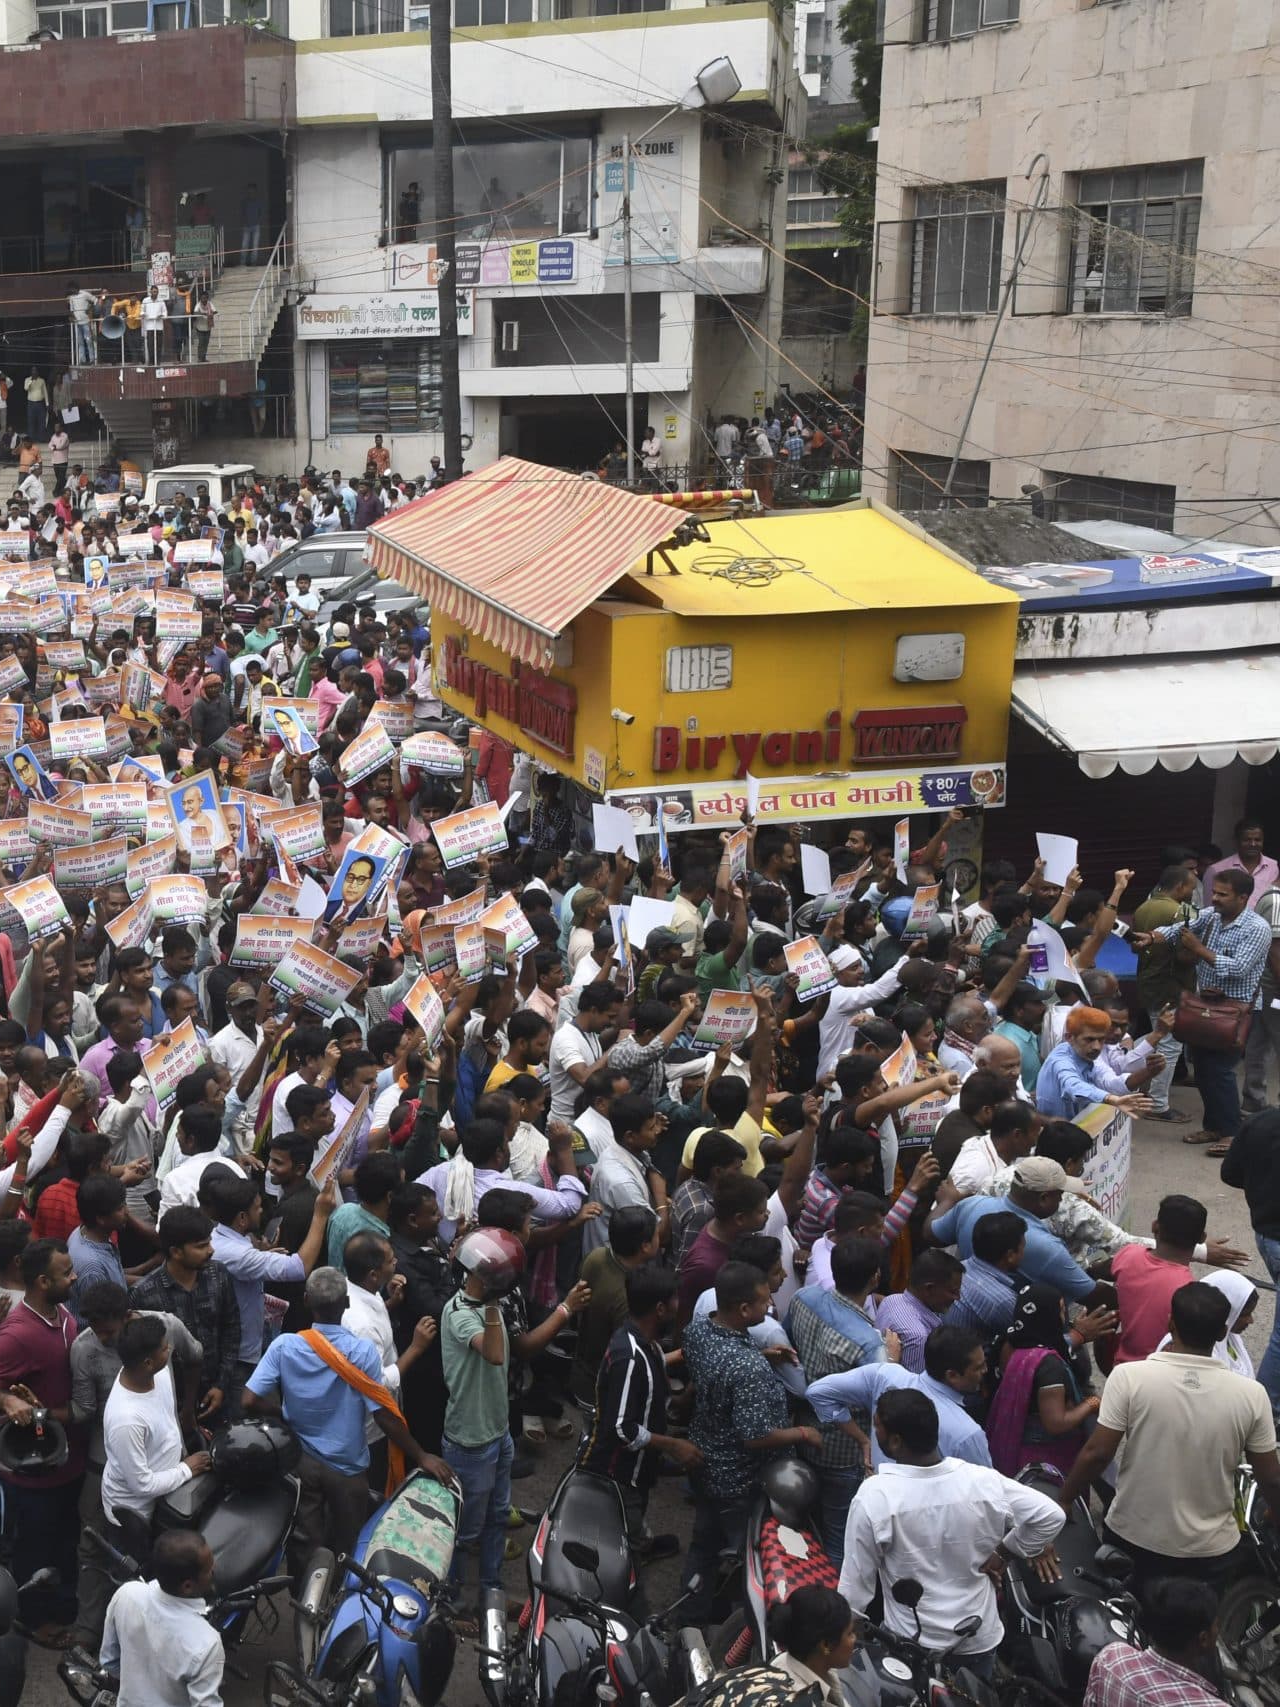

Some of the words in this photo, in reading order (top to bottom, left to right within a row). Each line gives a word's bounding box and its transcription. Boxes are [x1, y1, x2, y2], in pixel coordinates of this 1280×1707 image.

[645, 142, 674, 155] ZONE
[653, 710, 841, 779] Biryani
[859, 723, 961, 756] WINDOW
[790, 790, 837, 809] पाव
[847, 780, 914, 806] भाजी
[936, 791, 957, 802] प्लेट
